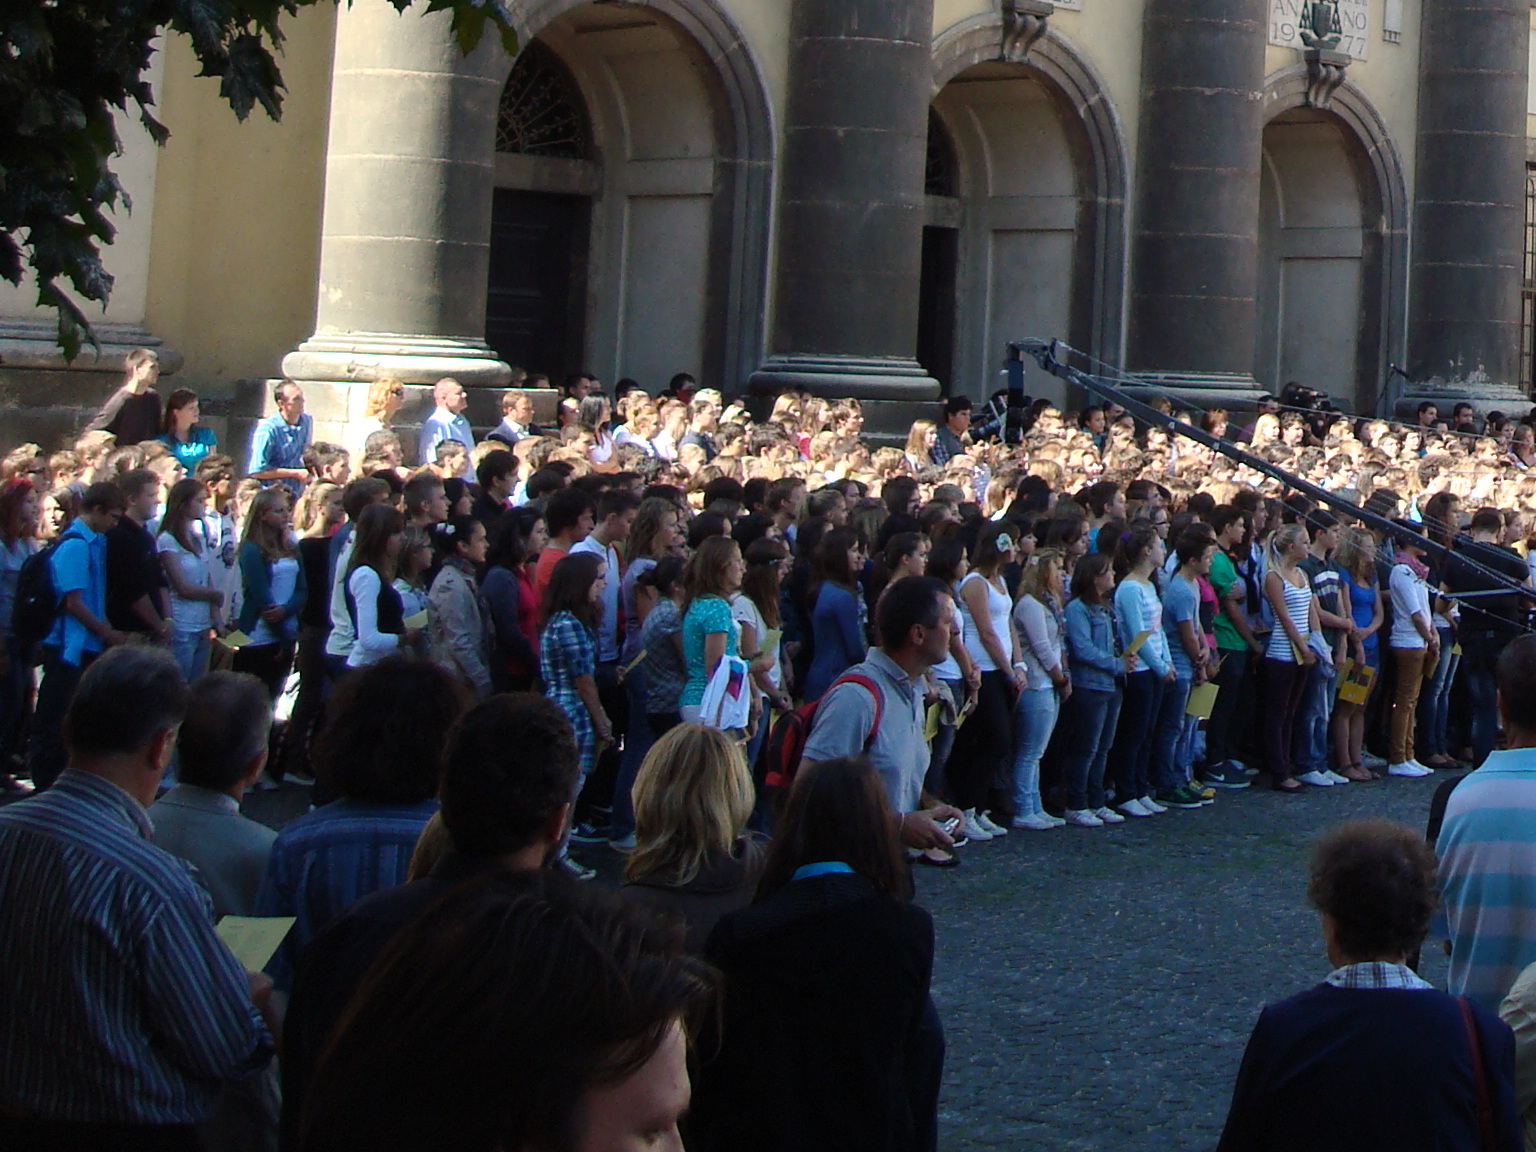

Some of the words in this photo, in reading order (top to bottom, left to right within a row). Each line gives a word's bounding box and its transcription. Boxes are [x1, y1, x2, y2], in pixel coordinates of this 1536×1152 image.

[1343, 9, 1367, 30] NO
[1273, 22, 1296, 42] 19
[1344, 34, 1366, 55] 77
